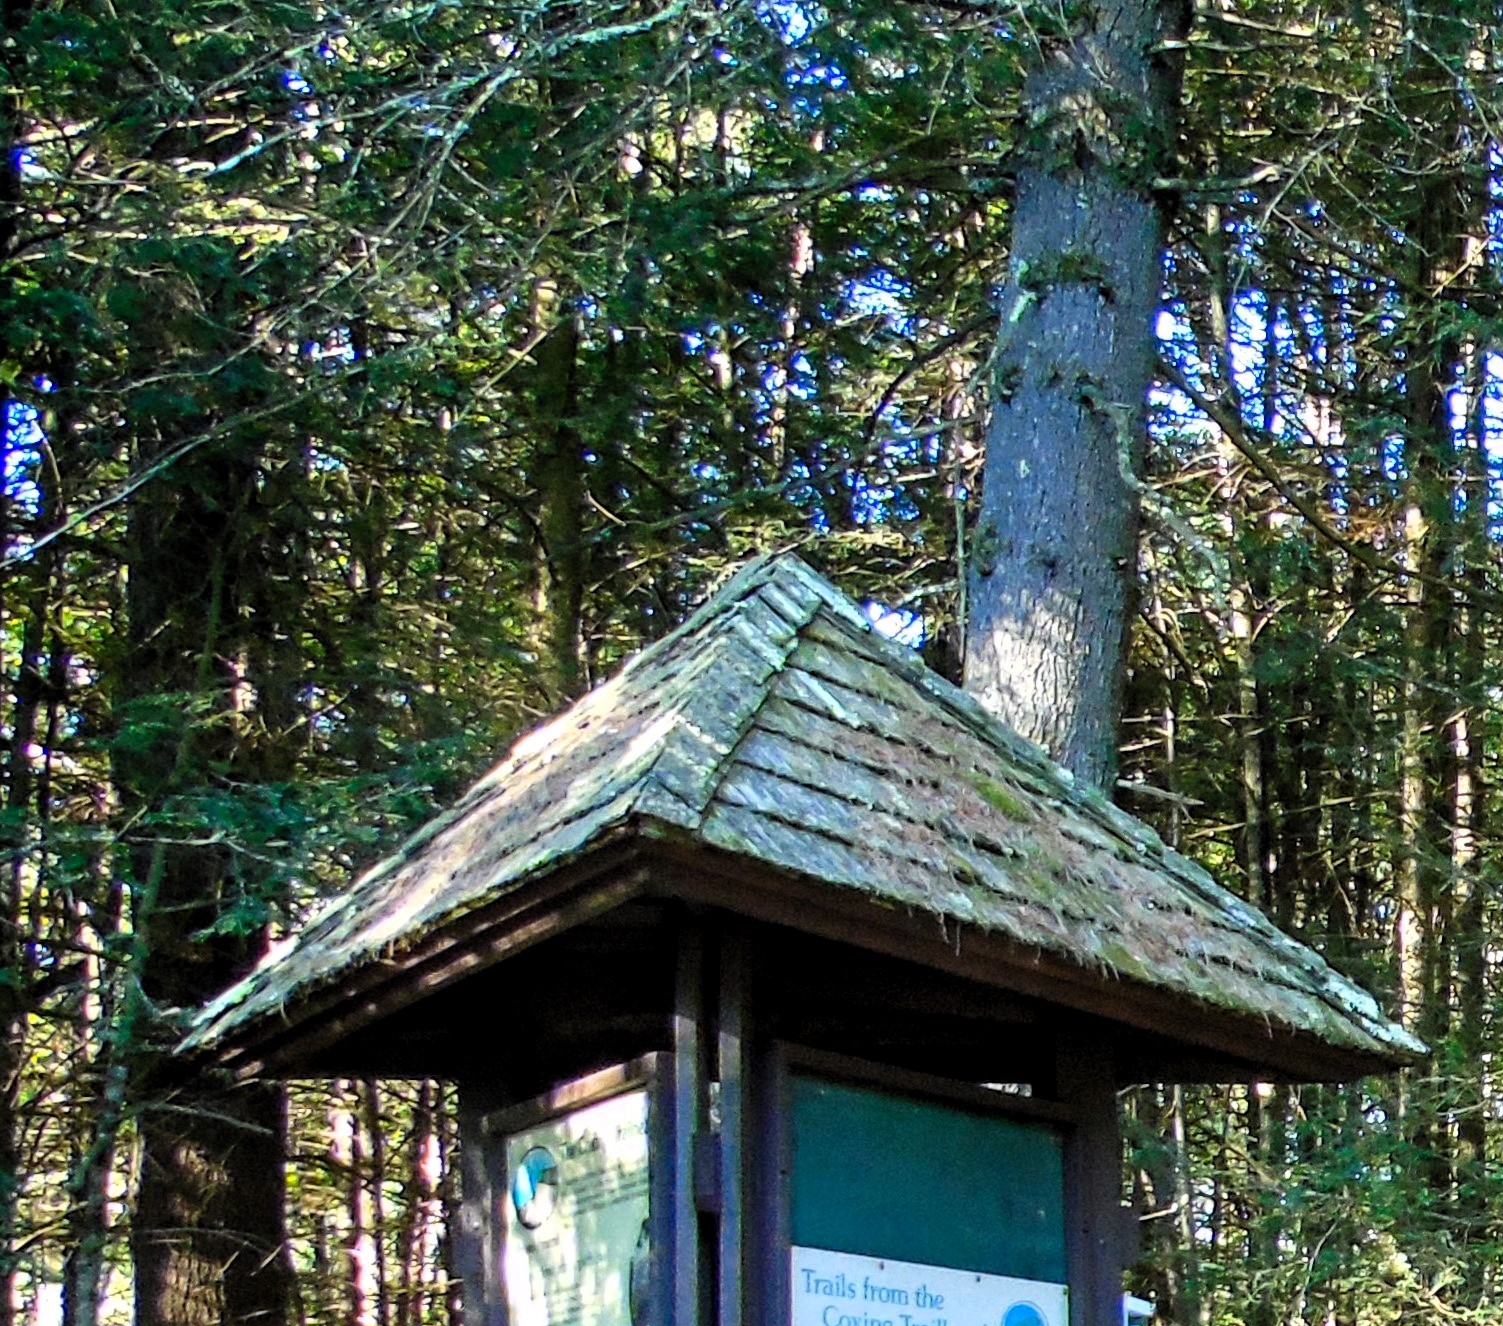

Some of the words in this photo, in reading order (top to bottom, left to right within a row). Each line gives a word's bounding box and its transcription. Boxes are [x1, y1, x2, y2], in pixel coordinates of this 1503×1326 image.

[801, 1269, 856, 1299] Trails
[864, 1277, 909, 1306] from
[915, 1285, 944, 1310] the
